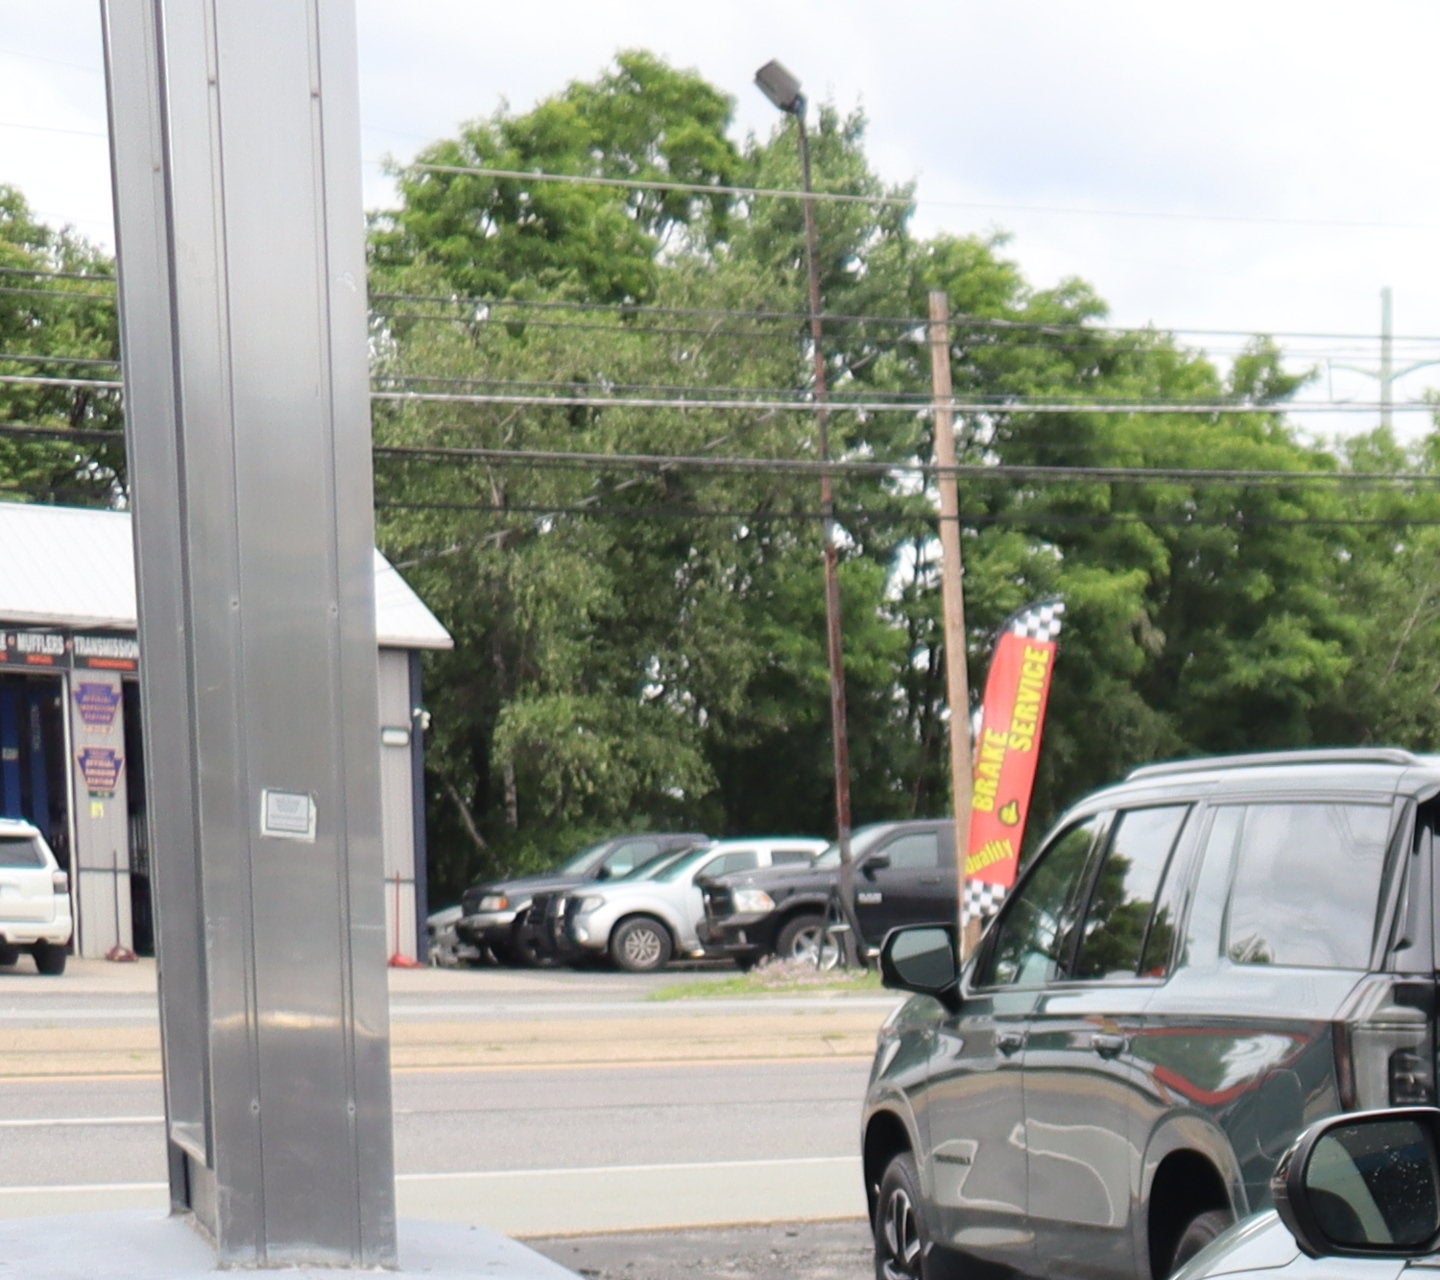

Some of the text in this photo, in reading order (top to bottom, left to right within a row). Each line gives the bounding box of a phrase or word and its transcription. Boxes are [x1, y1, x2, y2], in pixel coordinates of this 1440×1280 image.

[17, 631, 64, 656] MUFFLERS
[1008, 645, 1050, 752] SERVICE
[971, 727, 1008, 812] BRAKE
